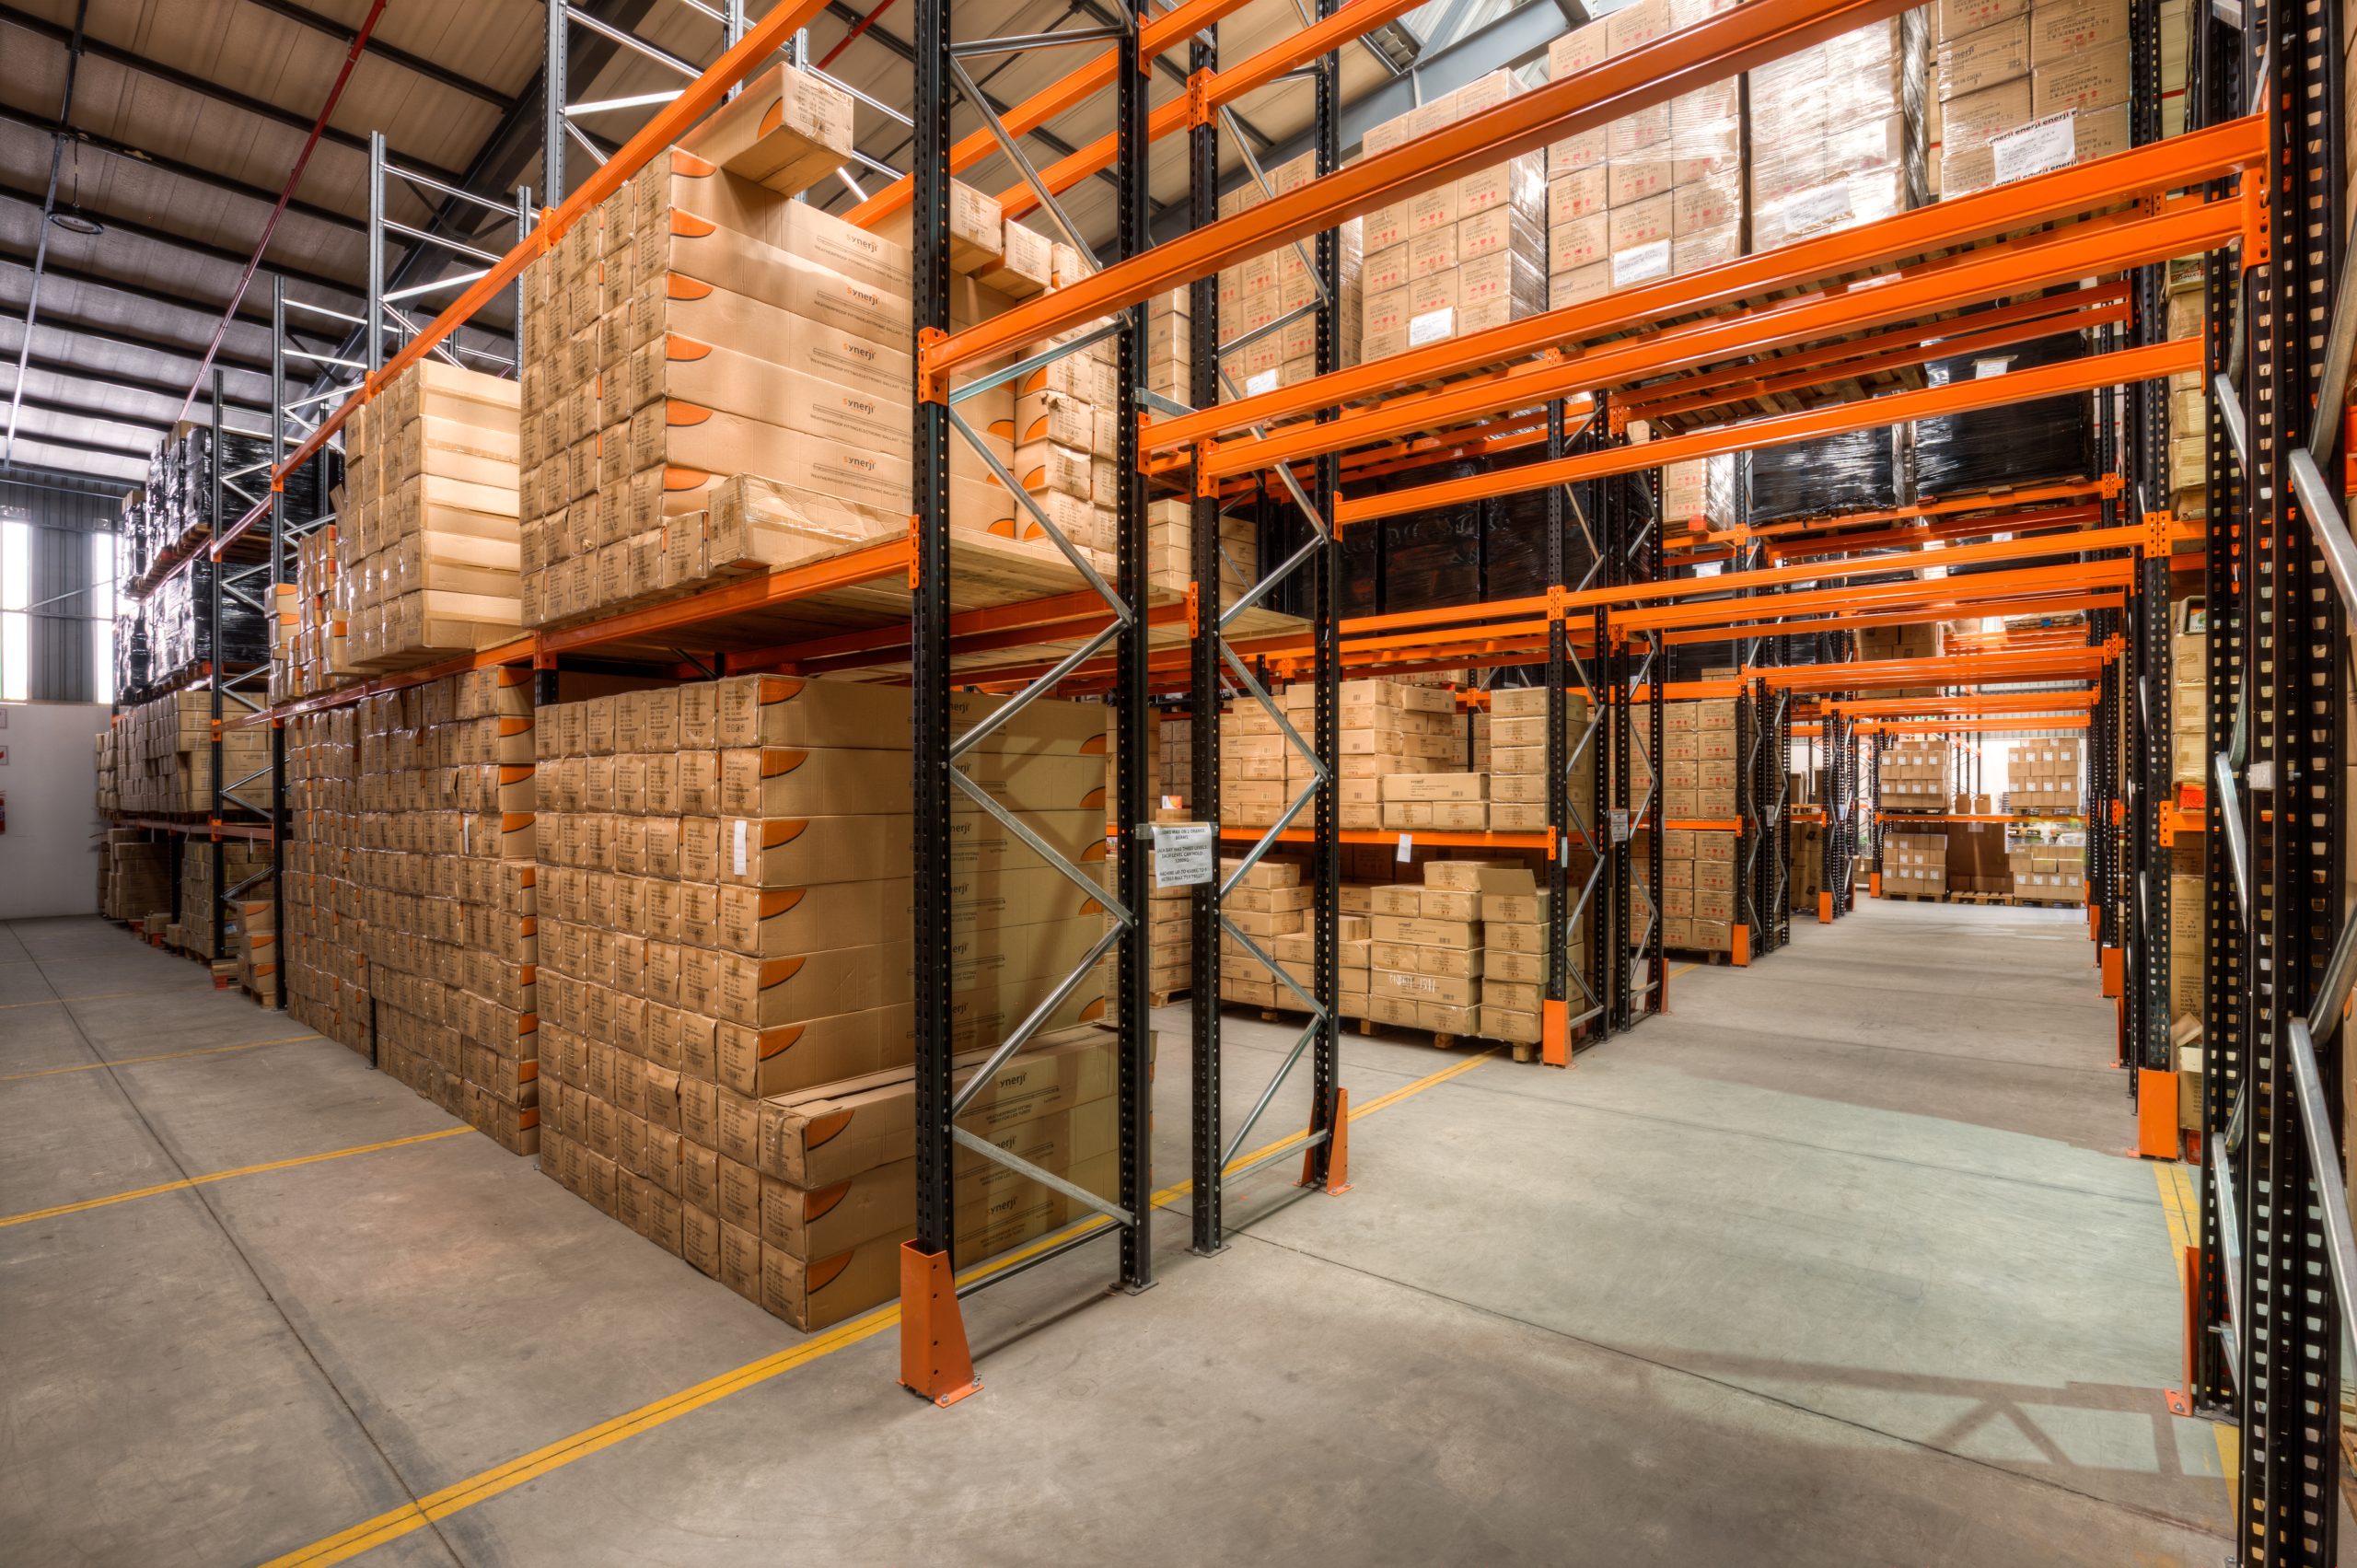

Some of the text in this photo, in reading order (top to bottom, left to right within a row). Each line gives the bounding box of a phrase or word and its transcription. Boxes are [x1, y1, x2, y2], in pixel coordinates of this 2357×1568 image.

[1989, 130, 2013, 144] enerji
[2015, 118, 2040, 135] enerji
[2043, 110, 2069, 125] enerji
[2050, 157, 2077, 170] enerji
[846, 286, 878, 306] synerji
[842, 343, 876, 361] synerji
[842, 398, 876, 414] synerji
[842, 456, 876, 470] synerji
[950, 703, 969, 714] nerji
[950, 821, 971, 834] nerji
[1000, 1073, 1028, 1088] ynerji
[995, 1135, 1017, 1149] nerji
